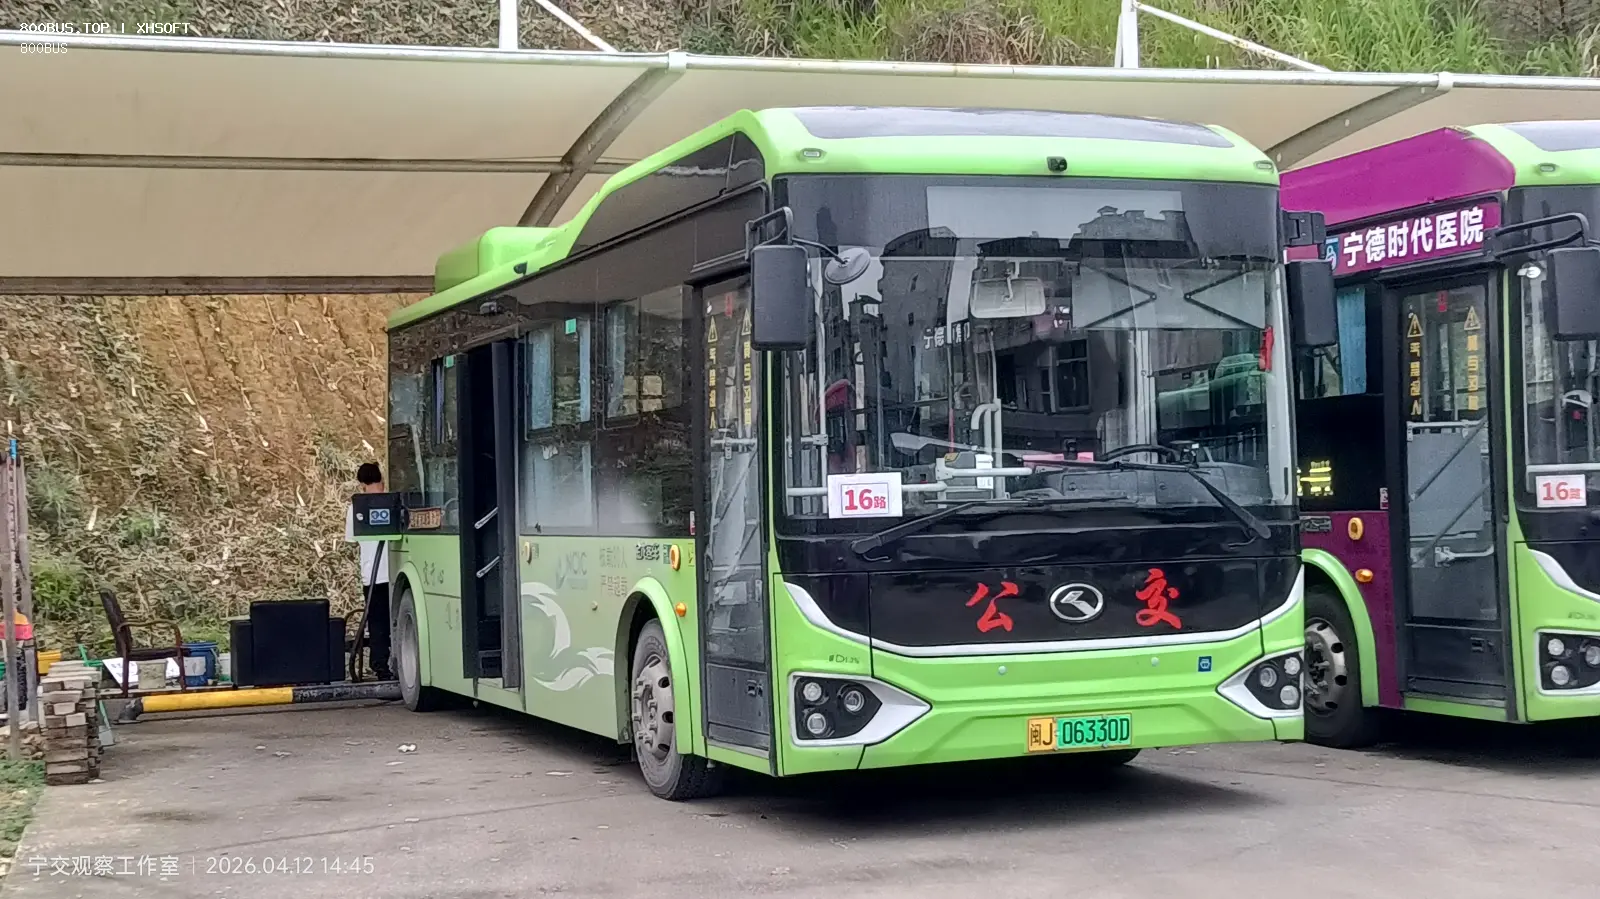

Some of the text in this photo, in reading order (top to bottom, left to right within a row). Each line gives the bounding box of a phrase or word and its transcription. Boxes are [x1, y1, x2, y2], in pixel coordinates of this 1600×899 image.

[1343, 206, 1484, 267] 宁德时代医院
[965, 568, 1182, 633] 公 交
[1062, 717, 1130, 745] 06330D
